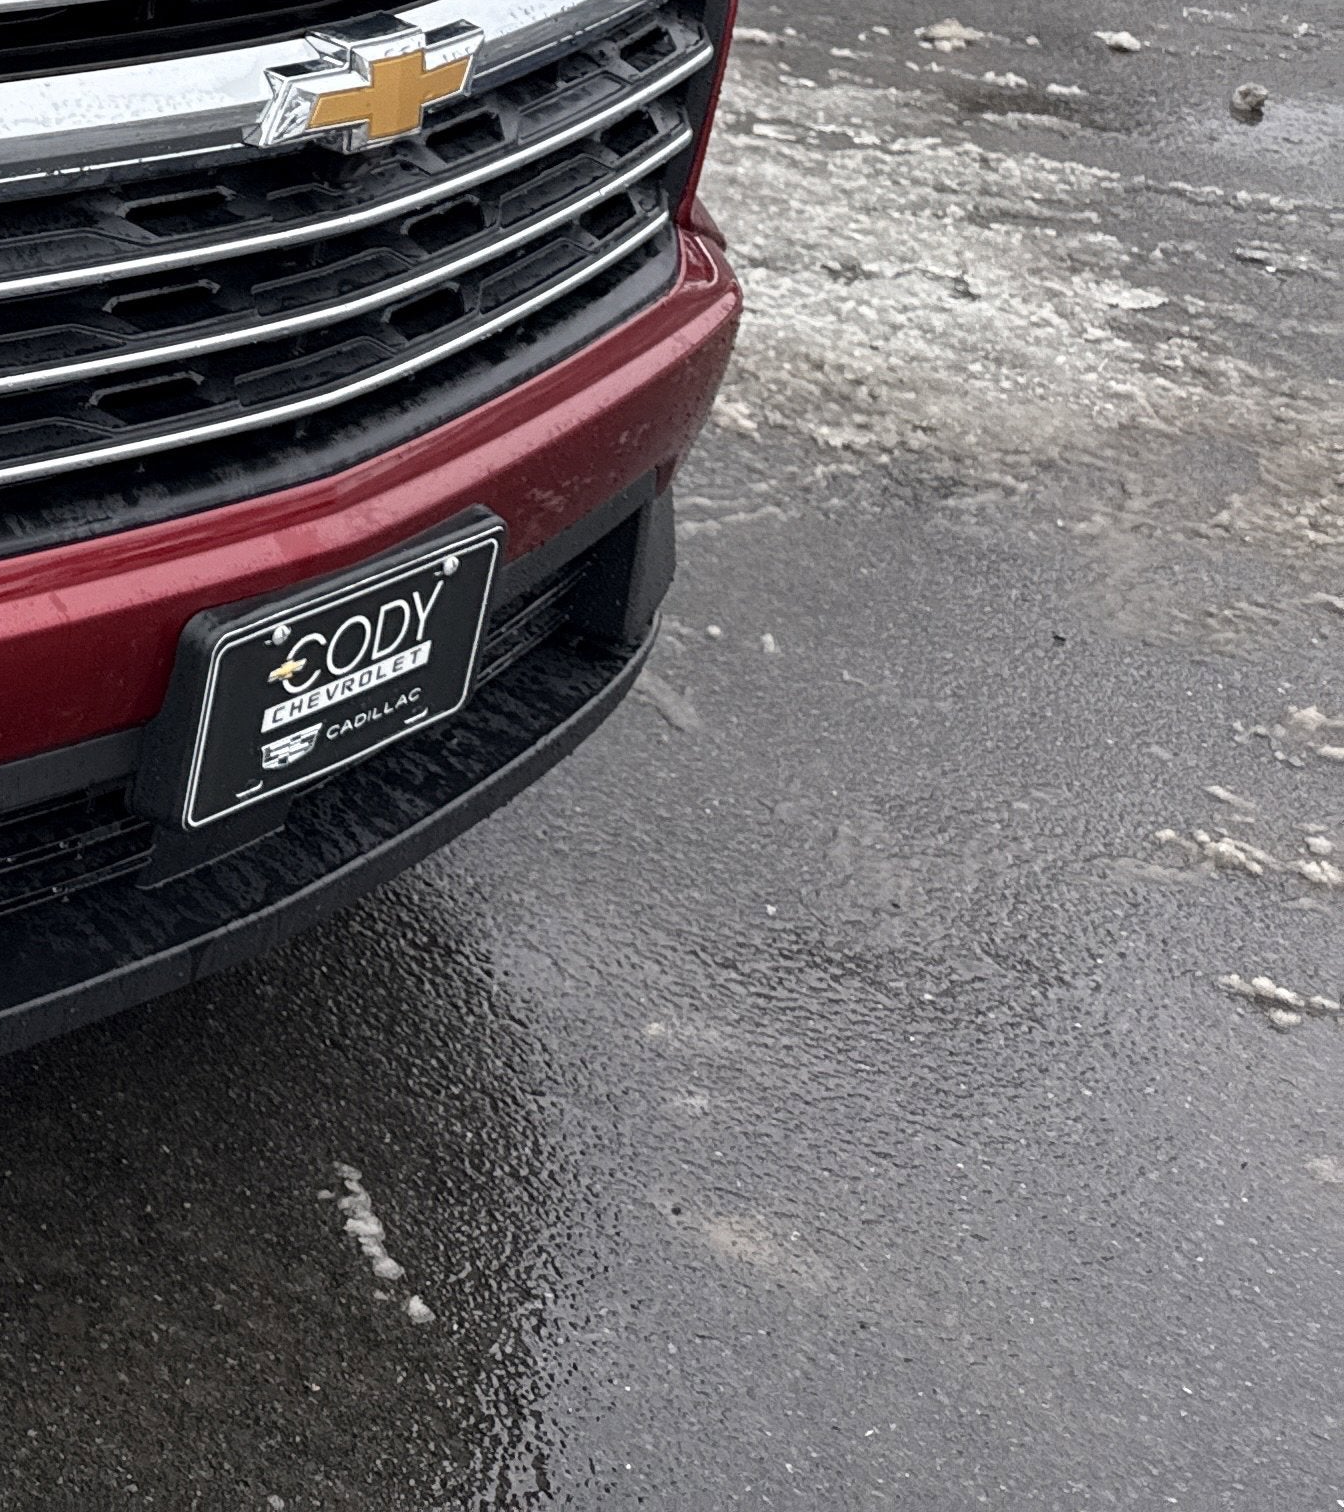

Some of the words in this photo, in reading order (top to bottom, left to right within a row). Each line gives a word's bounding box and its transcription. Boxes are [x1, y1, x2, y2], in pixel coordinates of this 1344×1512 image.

[283, 580, 444, 694] CODY
[270, 647, 424, 725] CHEVROLET
[326, 687, 422, 739] CADILLAC
